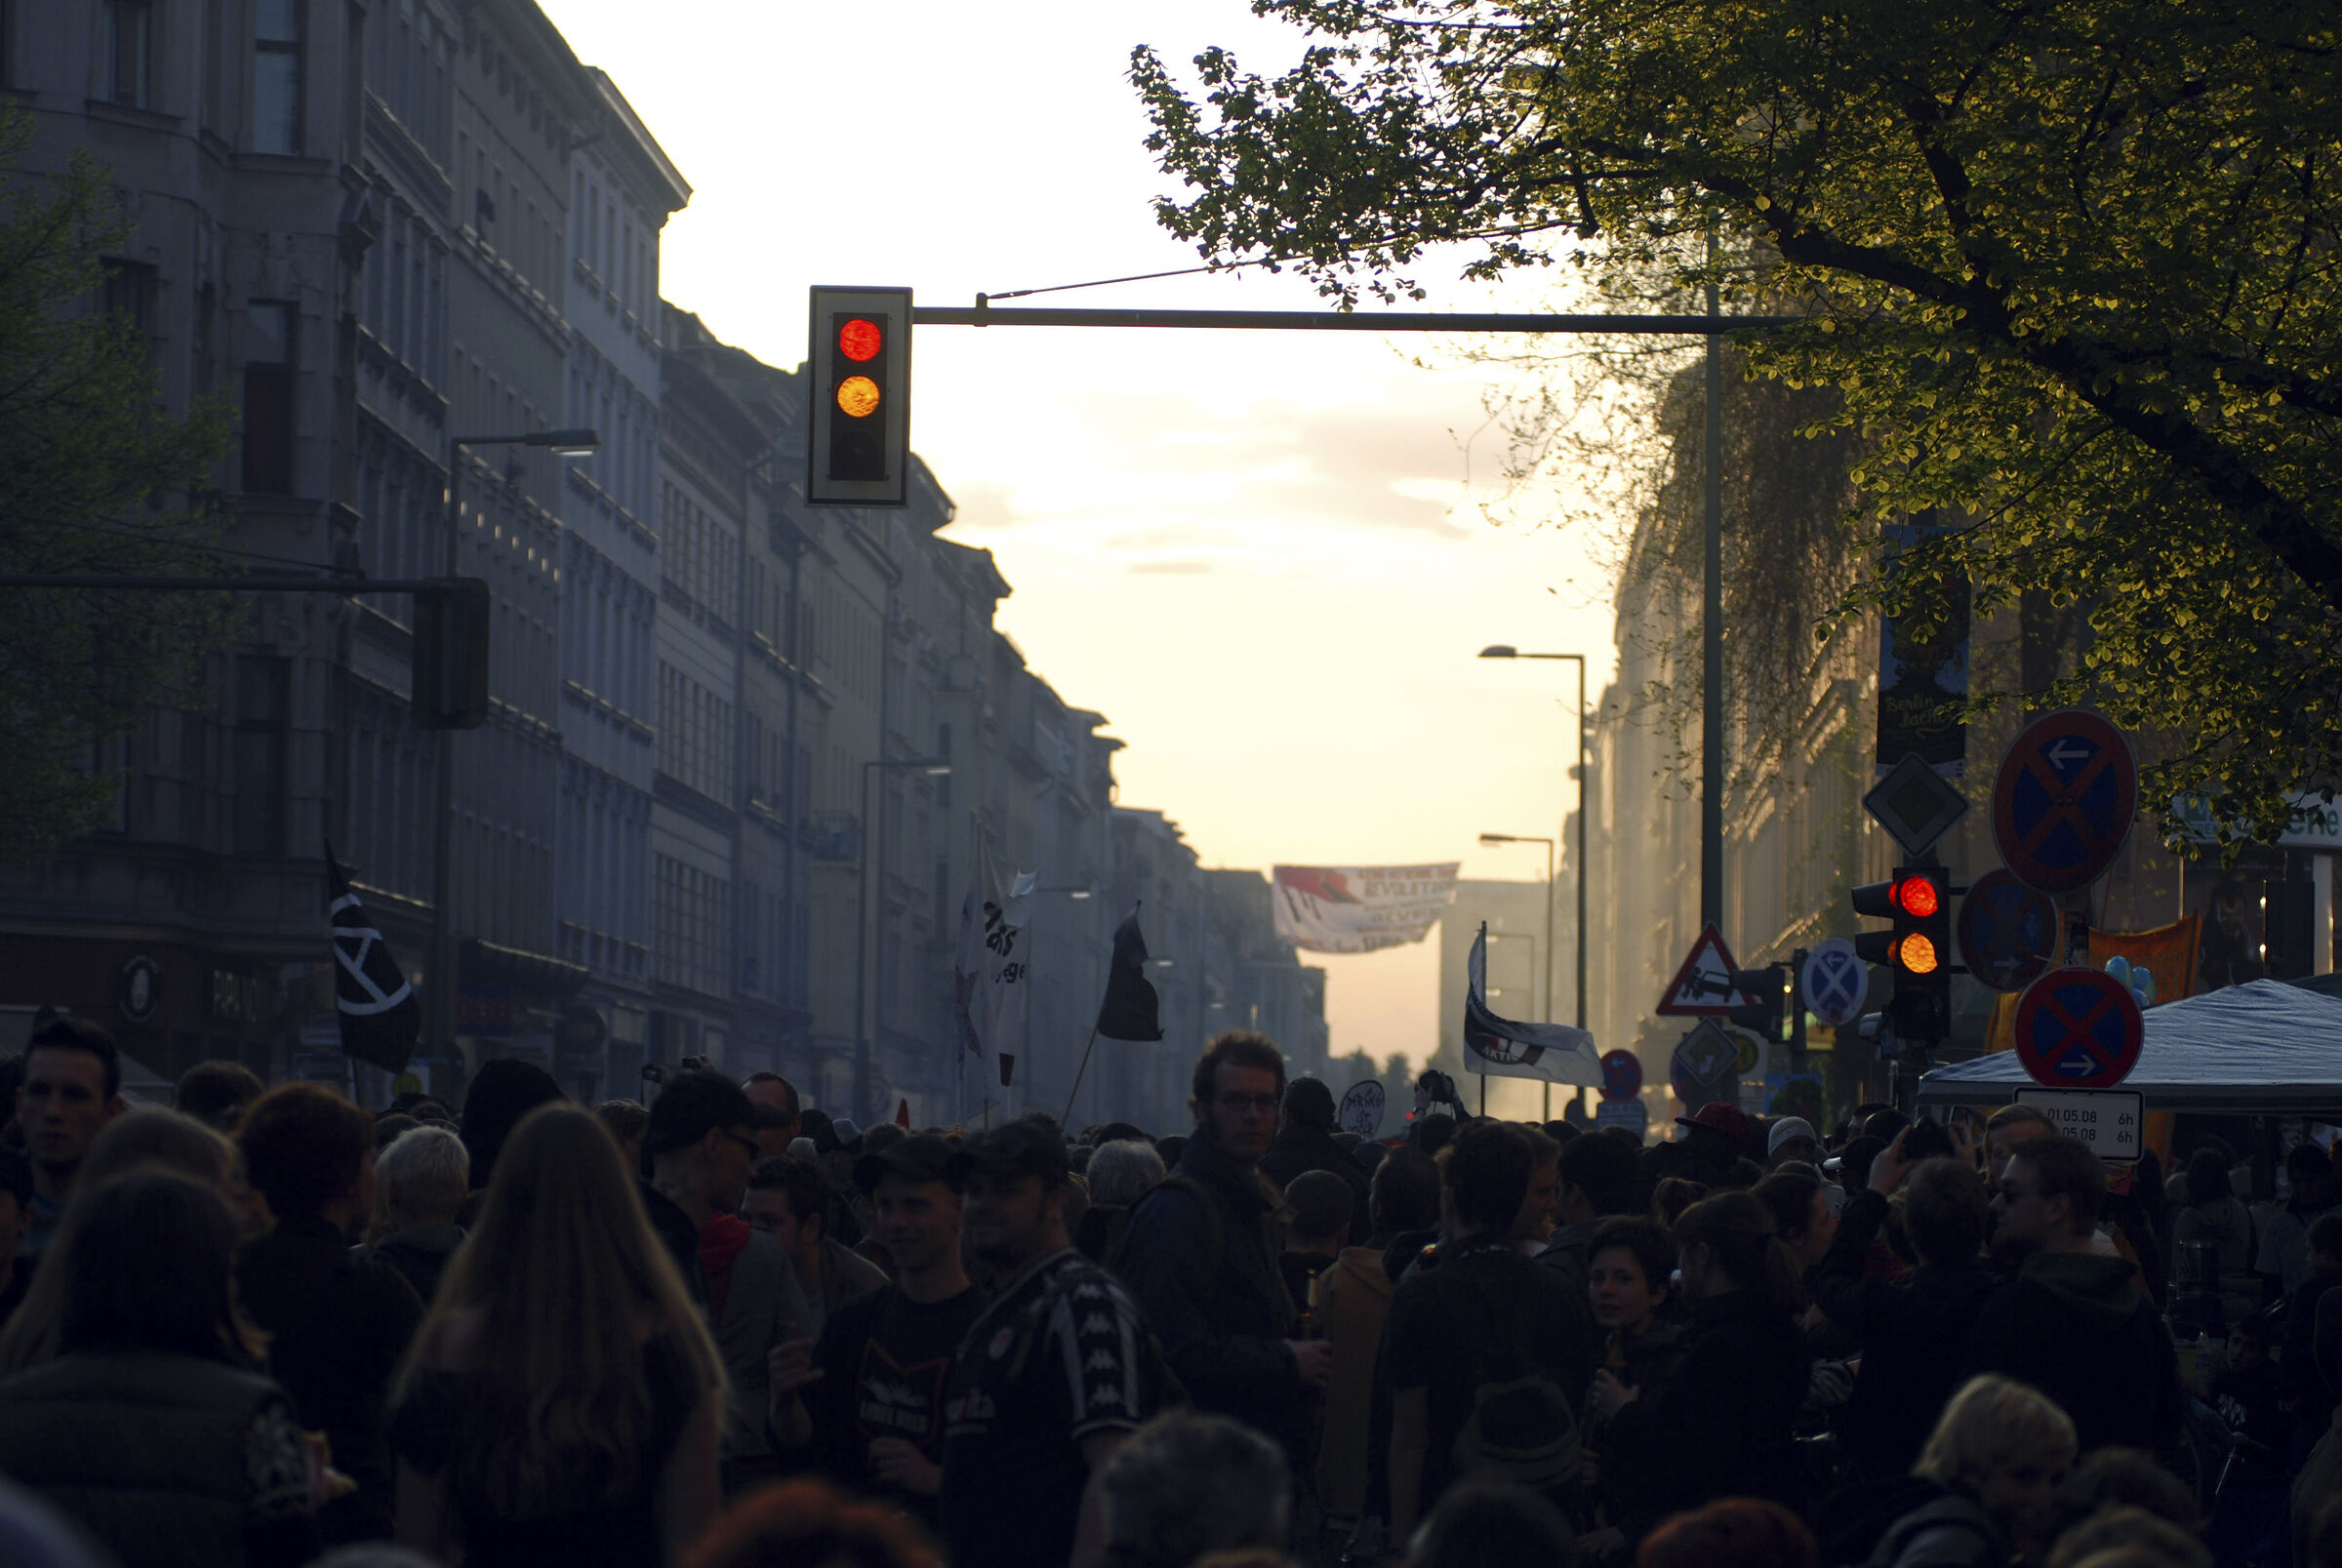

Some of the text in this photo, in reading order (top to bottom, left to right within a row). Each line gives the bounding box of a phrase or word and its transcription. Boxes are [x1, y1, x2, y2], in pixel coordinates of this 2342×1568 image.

[2047, 1108, 2133, 1125] 01.05.08 6h
[2062, 1127, 2132, 1143] 05.08 6h
